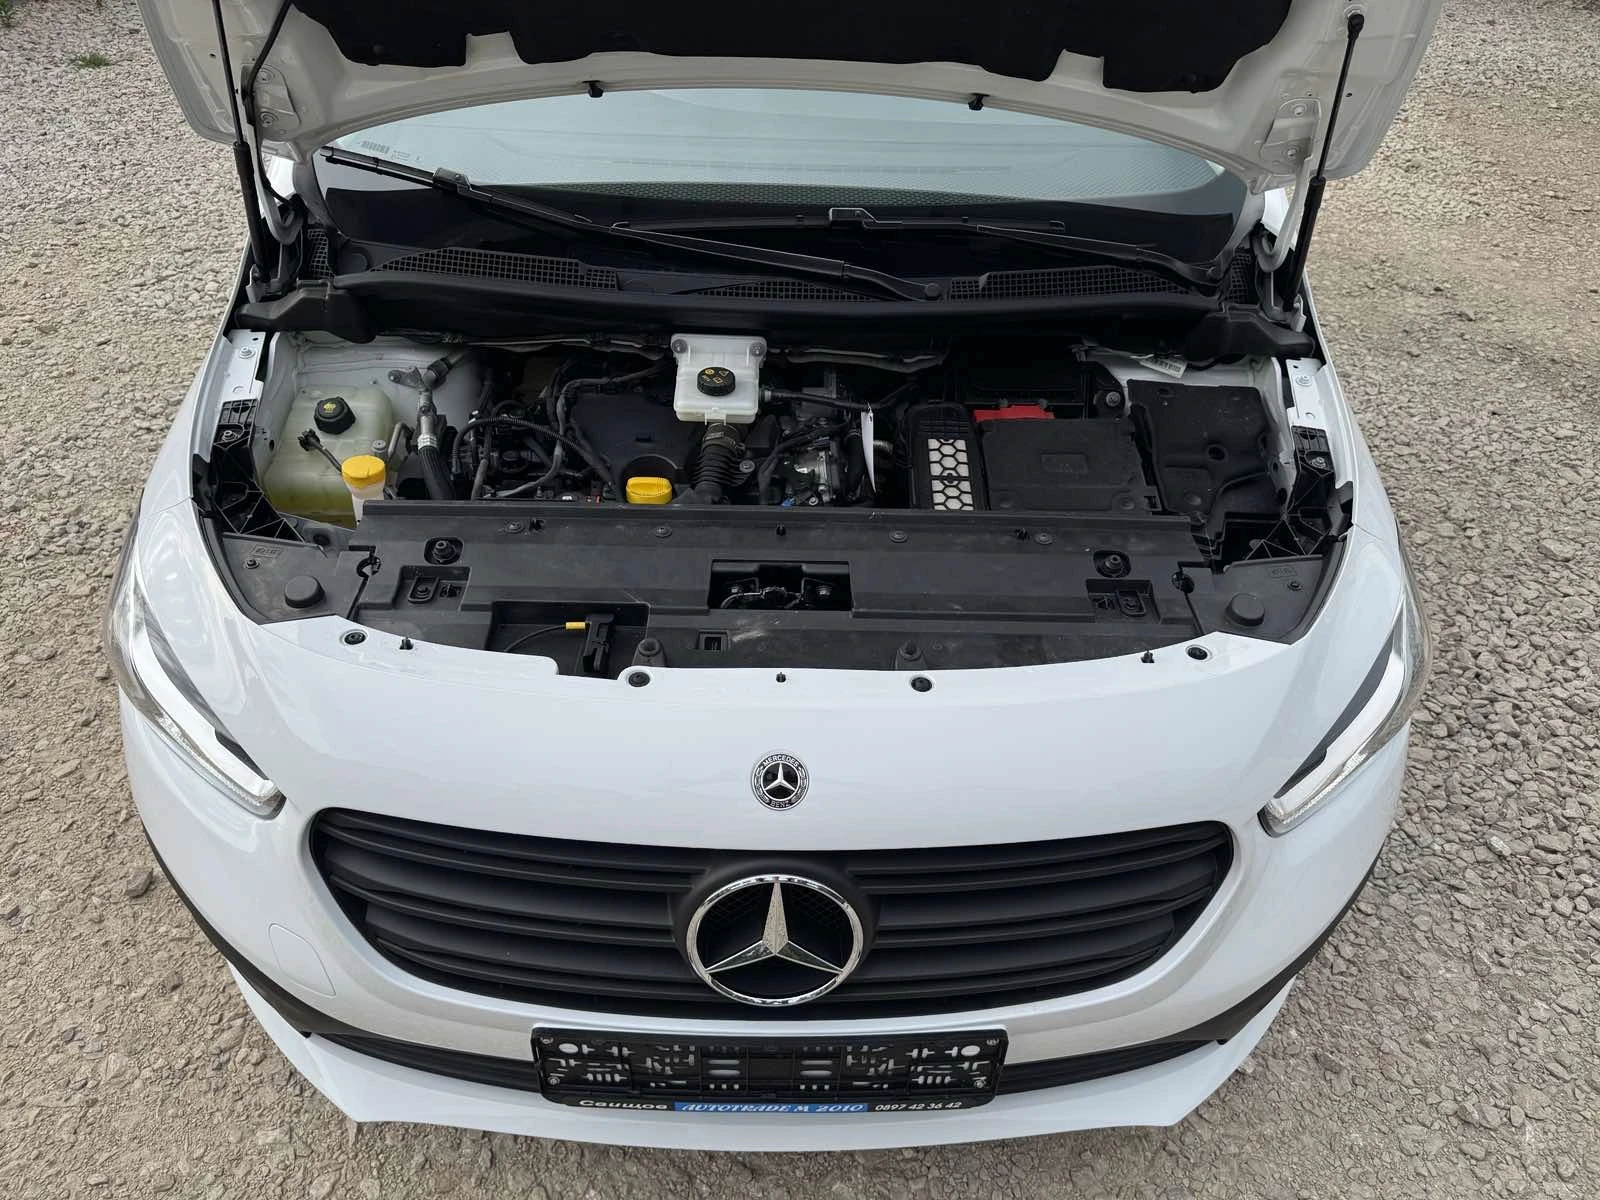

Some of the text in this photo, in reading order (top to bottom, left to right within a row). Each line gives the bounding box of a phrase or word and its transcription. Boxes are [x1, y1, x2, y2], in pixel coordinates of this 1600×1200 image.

[762, 754, 800, 767] MERCEDES
[770, 800, 791, 808] BENZ
[681, 1102, 865, 1112] AUTOTRADE M 2010
[875, 1103, 907, 1111] 0897
[926, 1102, 943, 1110] 36
[945, 1101, 962, 1109] 42
